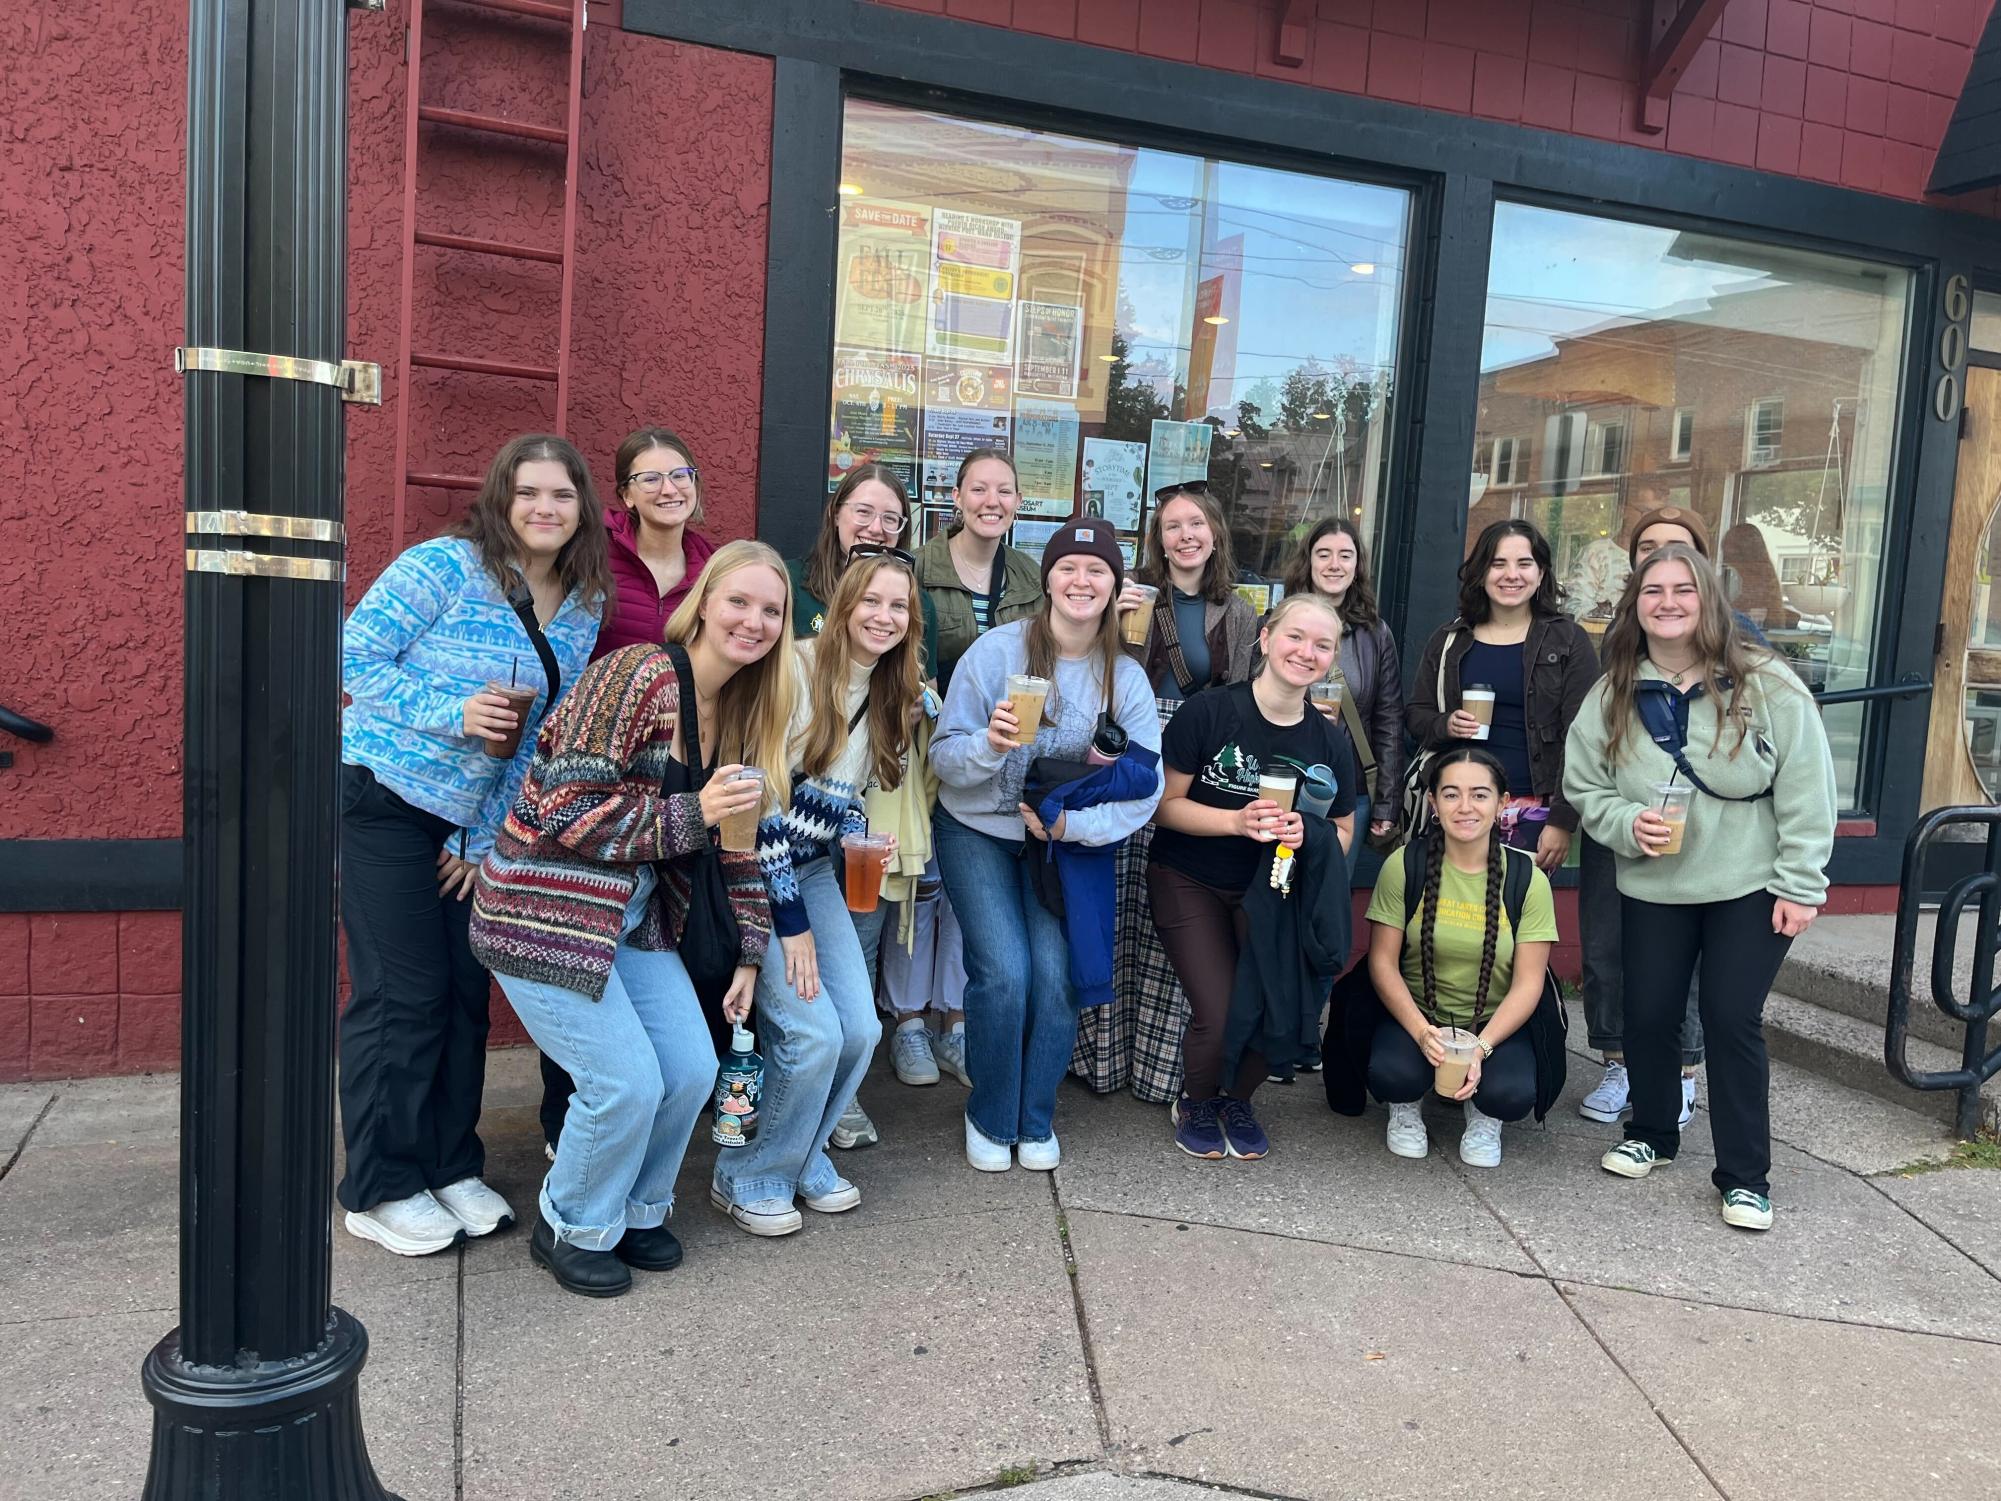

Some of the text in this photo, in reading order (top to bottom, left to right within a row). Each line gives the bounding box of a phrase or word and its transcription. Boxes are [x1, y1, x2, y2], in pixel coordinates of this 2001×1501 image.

[855, 207, 881, 222] SAVE
[892, 213, 918, 227] DATE
[1025, 303, 1044, 316] STEPS
[1052, 308, 1075, 319] HONOR
[1935, 274, 1968, 422] 600
[1024, 363, 1056, 374] SEPTEMBER
[835, 367, 916, 395] CHRYSALIS
[1016, 504, 1037, 512] USEUM
